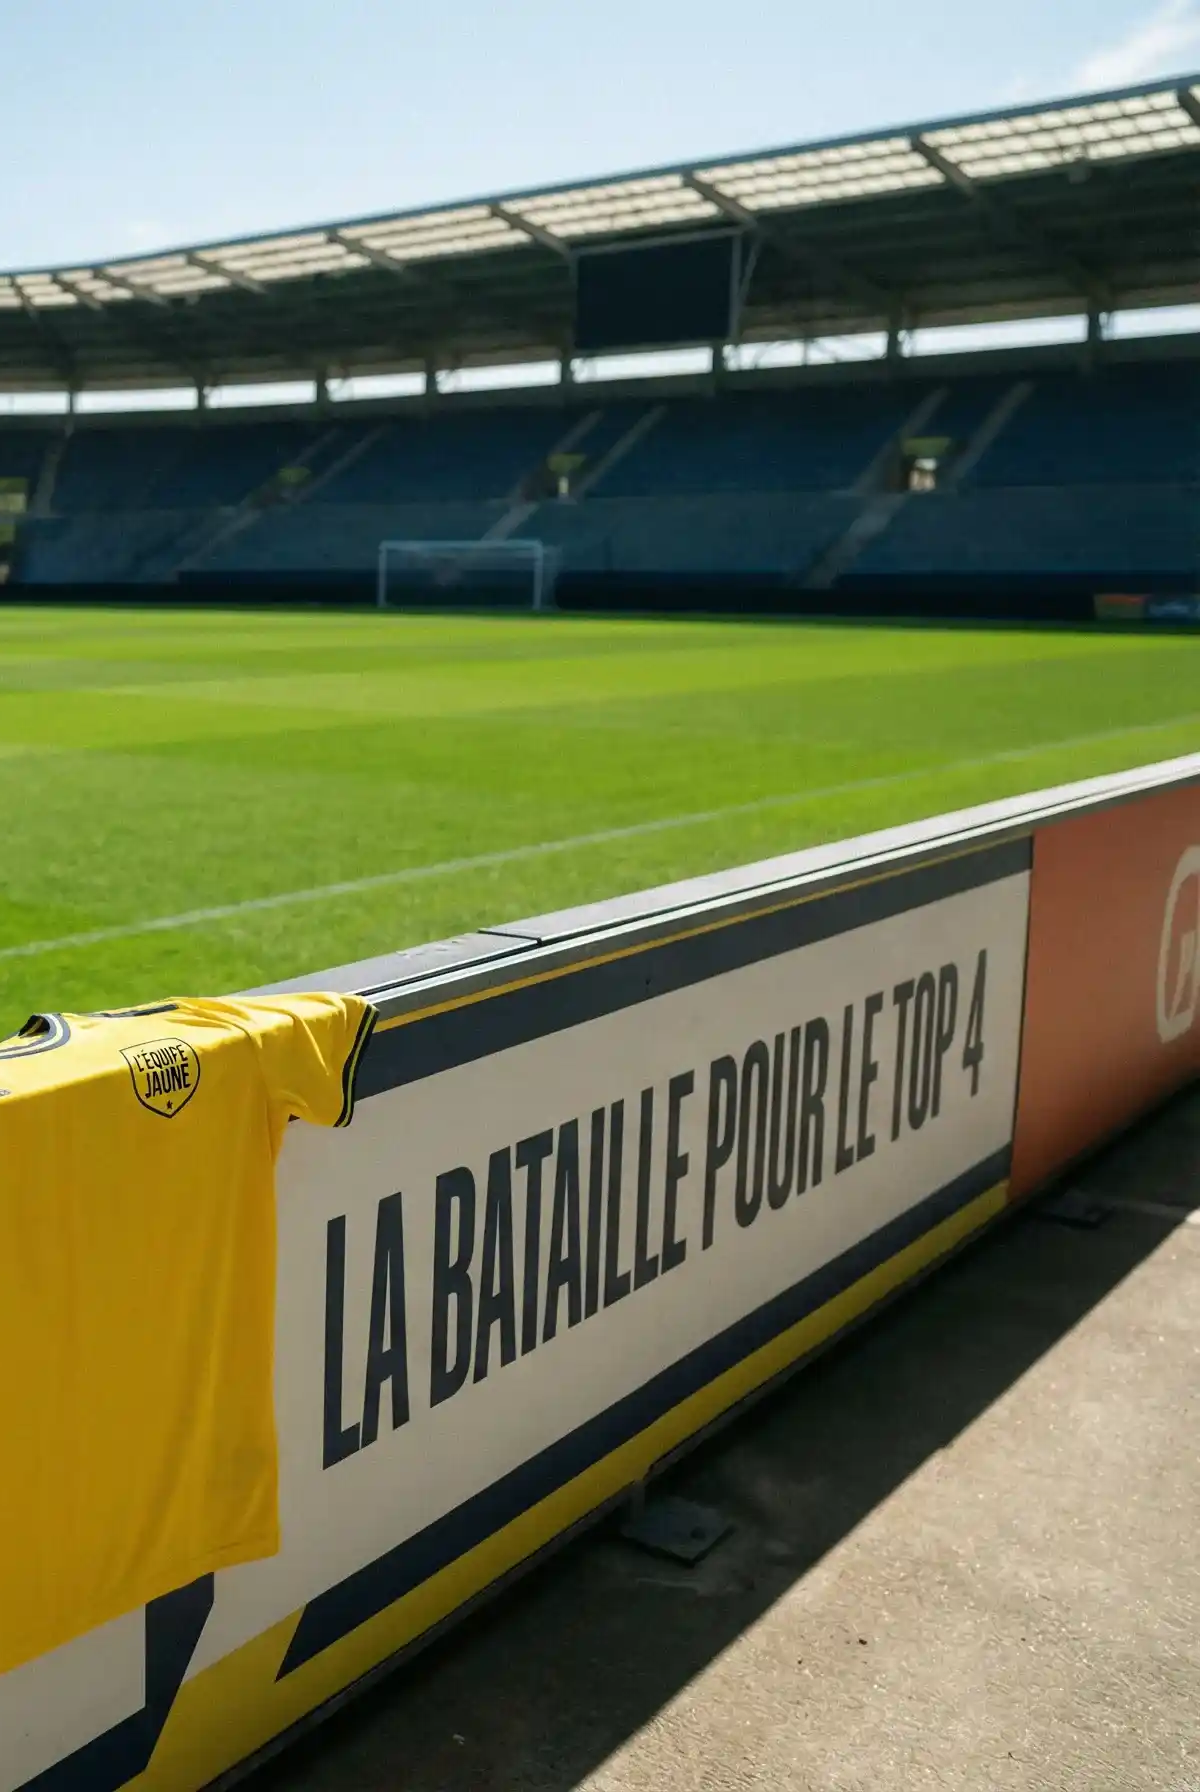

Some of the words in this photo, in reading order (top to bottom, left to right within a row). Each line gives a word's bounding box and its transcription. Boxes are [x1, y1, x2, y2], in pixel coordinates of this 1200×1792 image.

[133, 1044, 188, 1072] L'ÉQUIPE
[145, 1063, 191, 1099] JAUNE
[322, 1191, 410, 1471] LA
[429, 1069, 695, 1409] BATAILLE
[701, 1016, 830, 1251] POUR
[834, 991, 884, 1175] LE
[890, 961, 959, 1142] TOP
[962, 949, 987, 1097] 4
